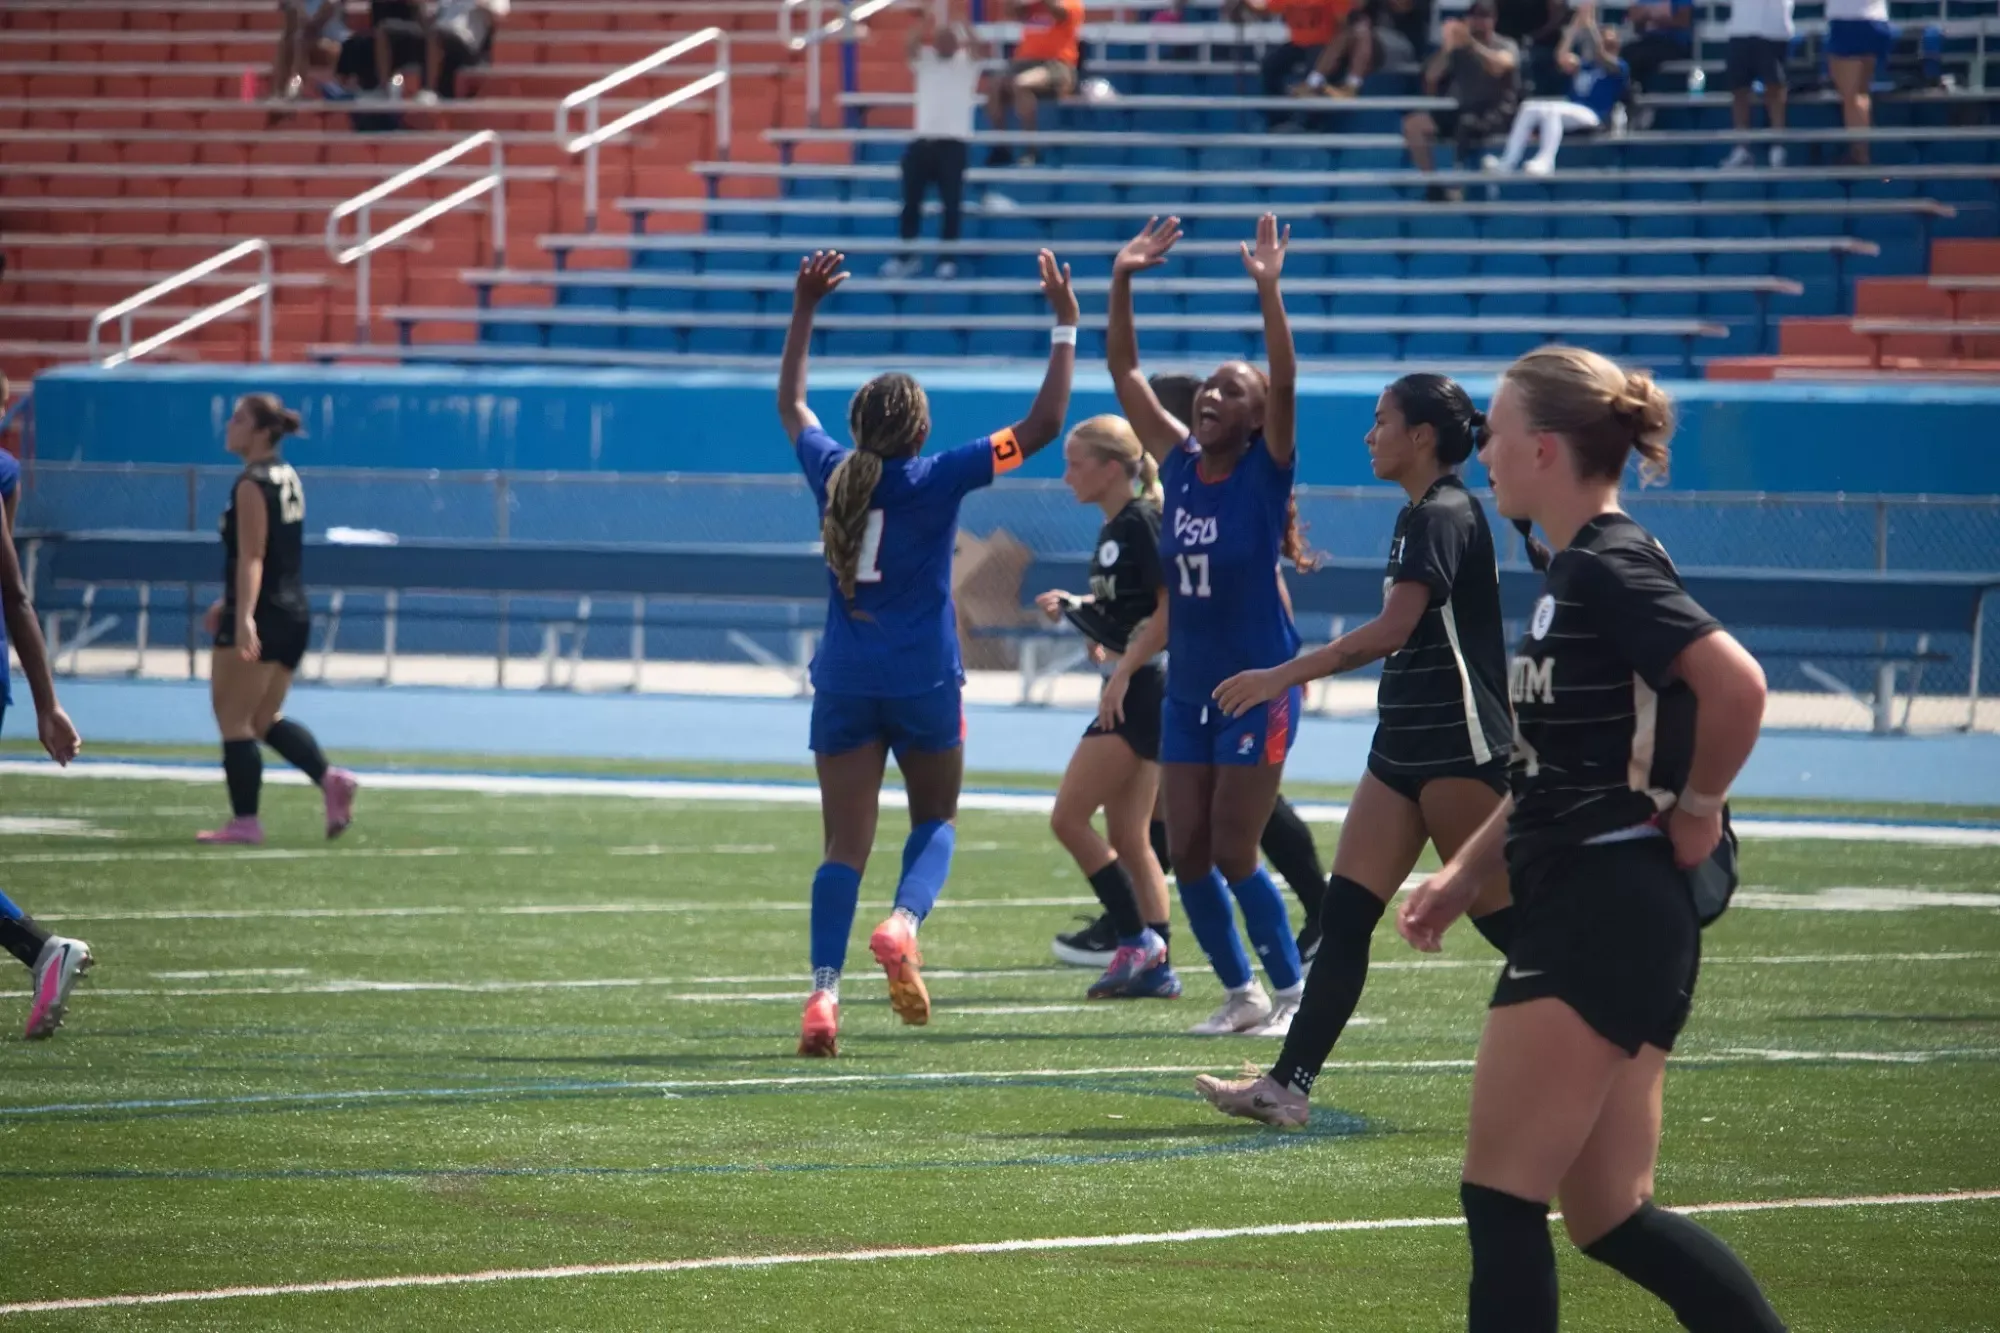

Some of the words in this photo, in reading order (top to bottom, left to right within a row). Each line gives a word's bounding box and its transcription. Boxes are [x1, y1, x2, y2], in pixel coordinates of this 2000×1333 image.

[994, 440, 1017, 460] C
[1174, 506, 1219, 548] VSU
[1175, 553, 1212, 597] 17
